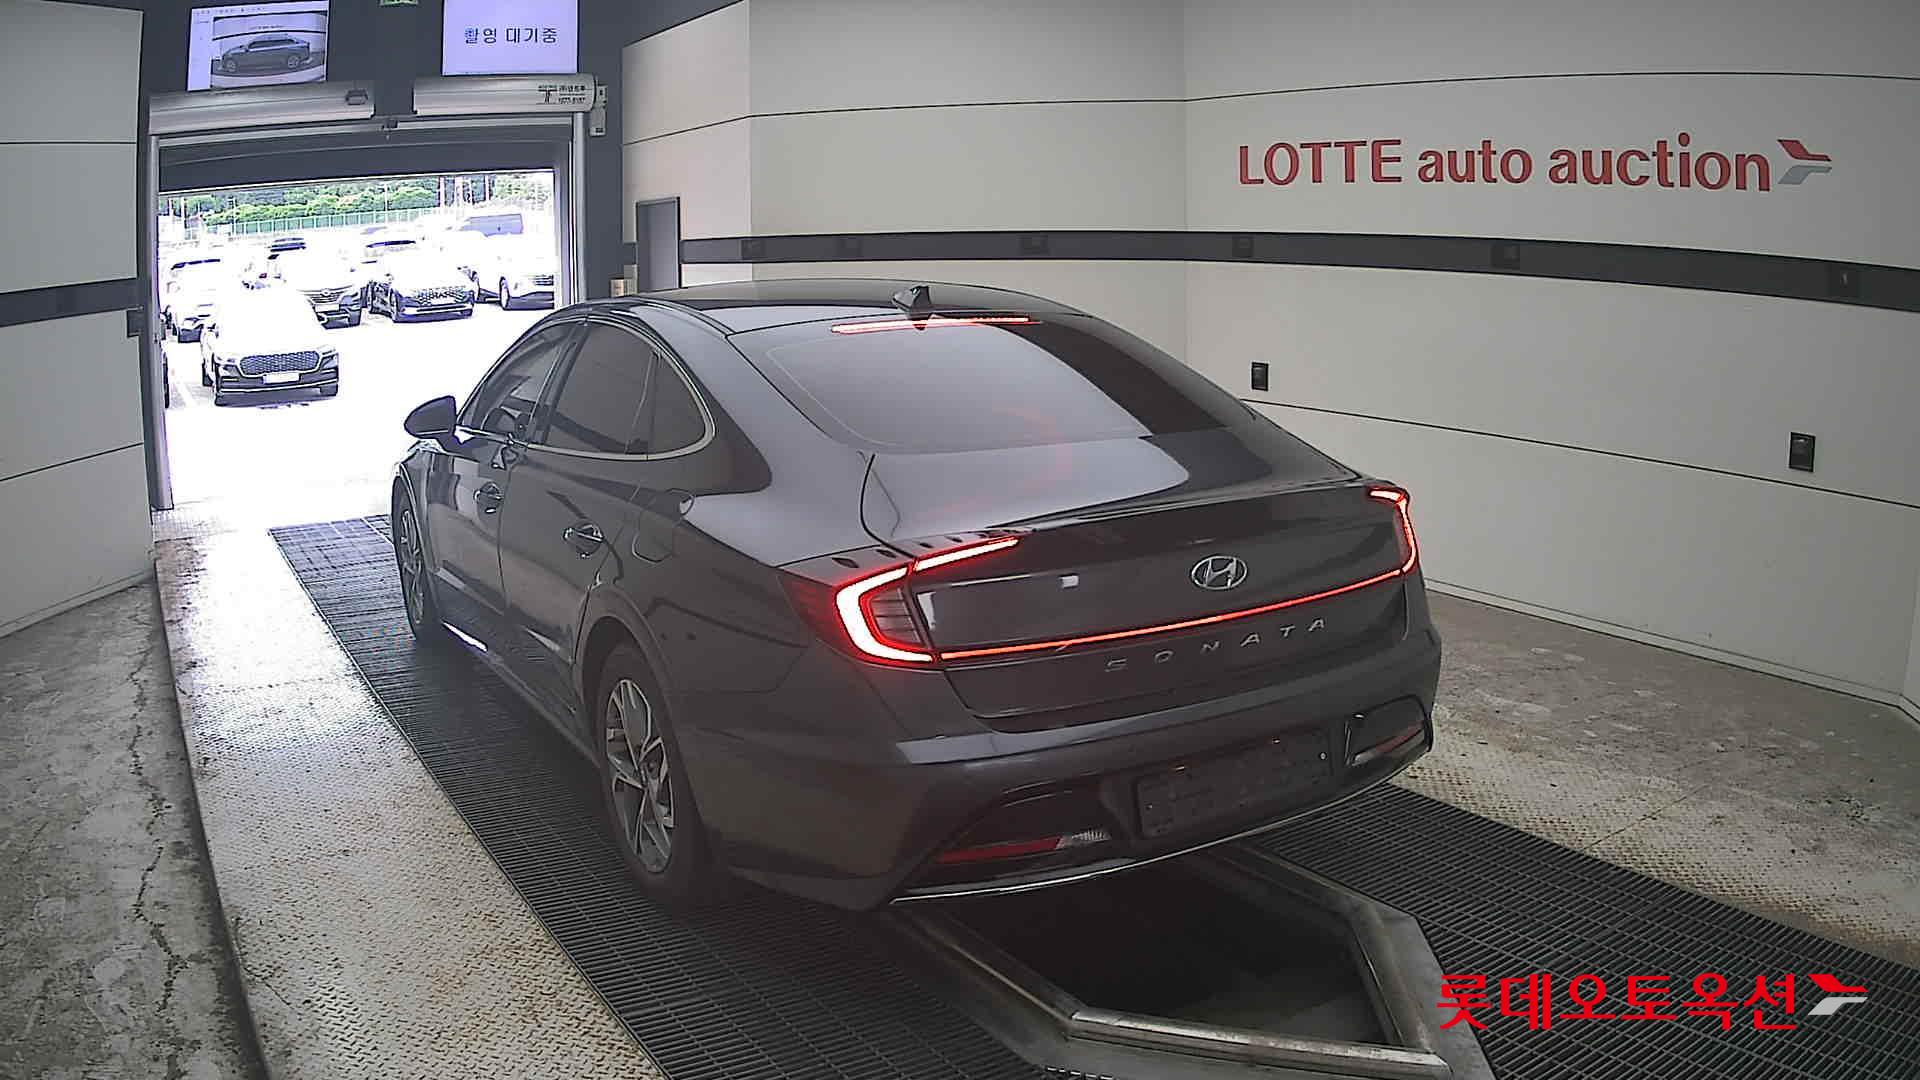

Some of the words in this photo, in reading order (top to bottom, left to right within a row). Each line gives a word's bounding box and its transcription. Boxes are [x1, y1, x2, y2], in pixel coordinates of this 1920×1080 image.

[506, 27, 558, 43] 대기중
[1239, 139, 1402, 185] LOTTE
[1418, 139, 1533, 183] auto
[1549, 132, 1771, 192] auction
[1104, 618, 1326, 673] SONATA
